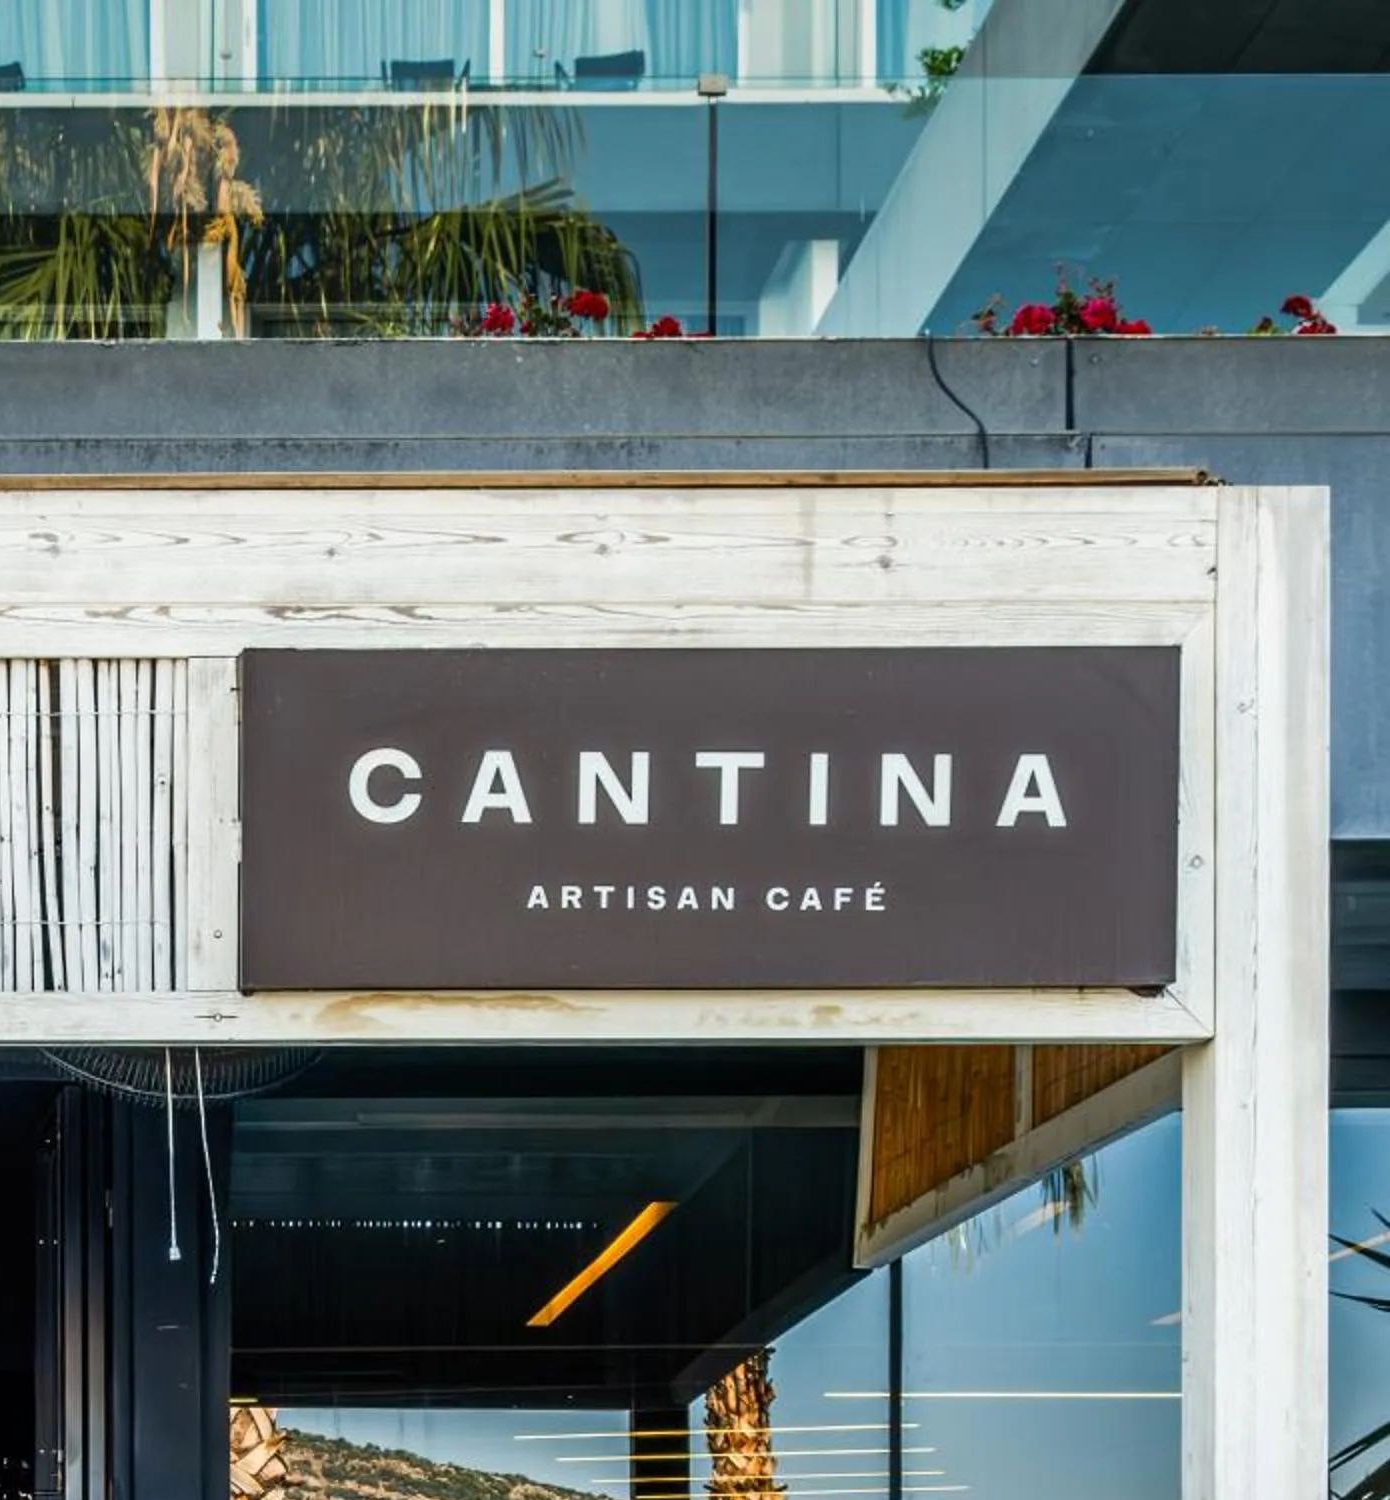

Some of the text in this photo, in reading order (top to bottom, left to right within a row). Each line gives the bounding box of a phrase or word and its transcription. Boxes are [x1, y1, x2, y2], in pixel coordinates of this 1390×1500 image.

[348, 748, 1069, 828] CANTINA
[527, 882, 887, 912] ARTISAN CAFÉ
